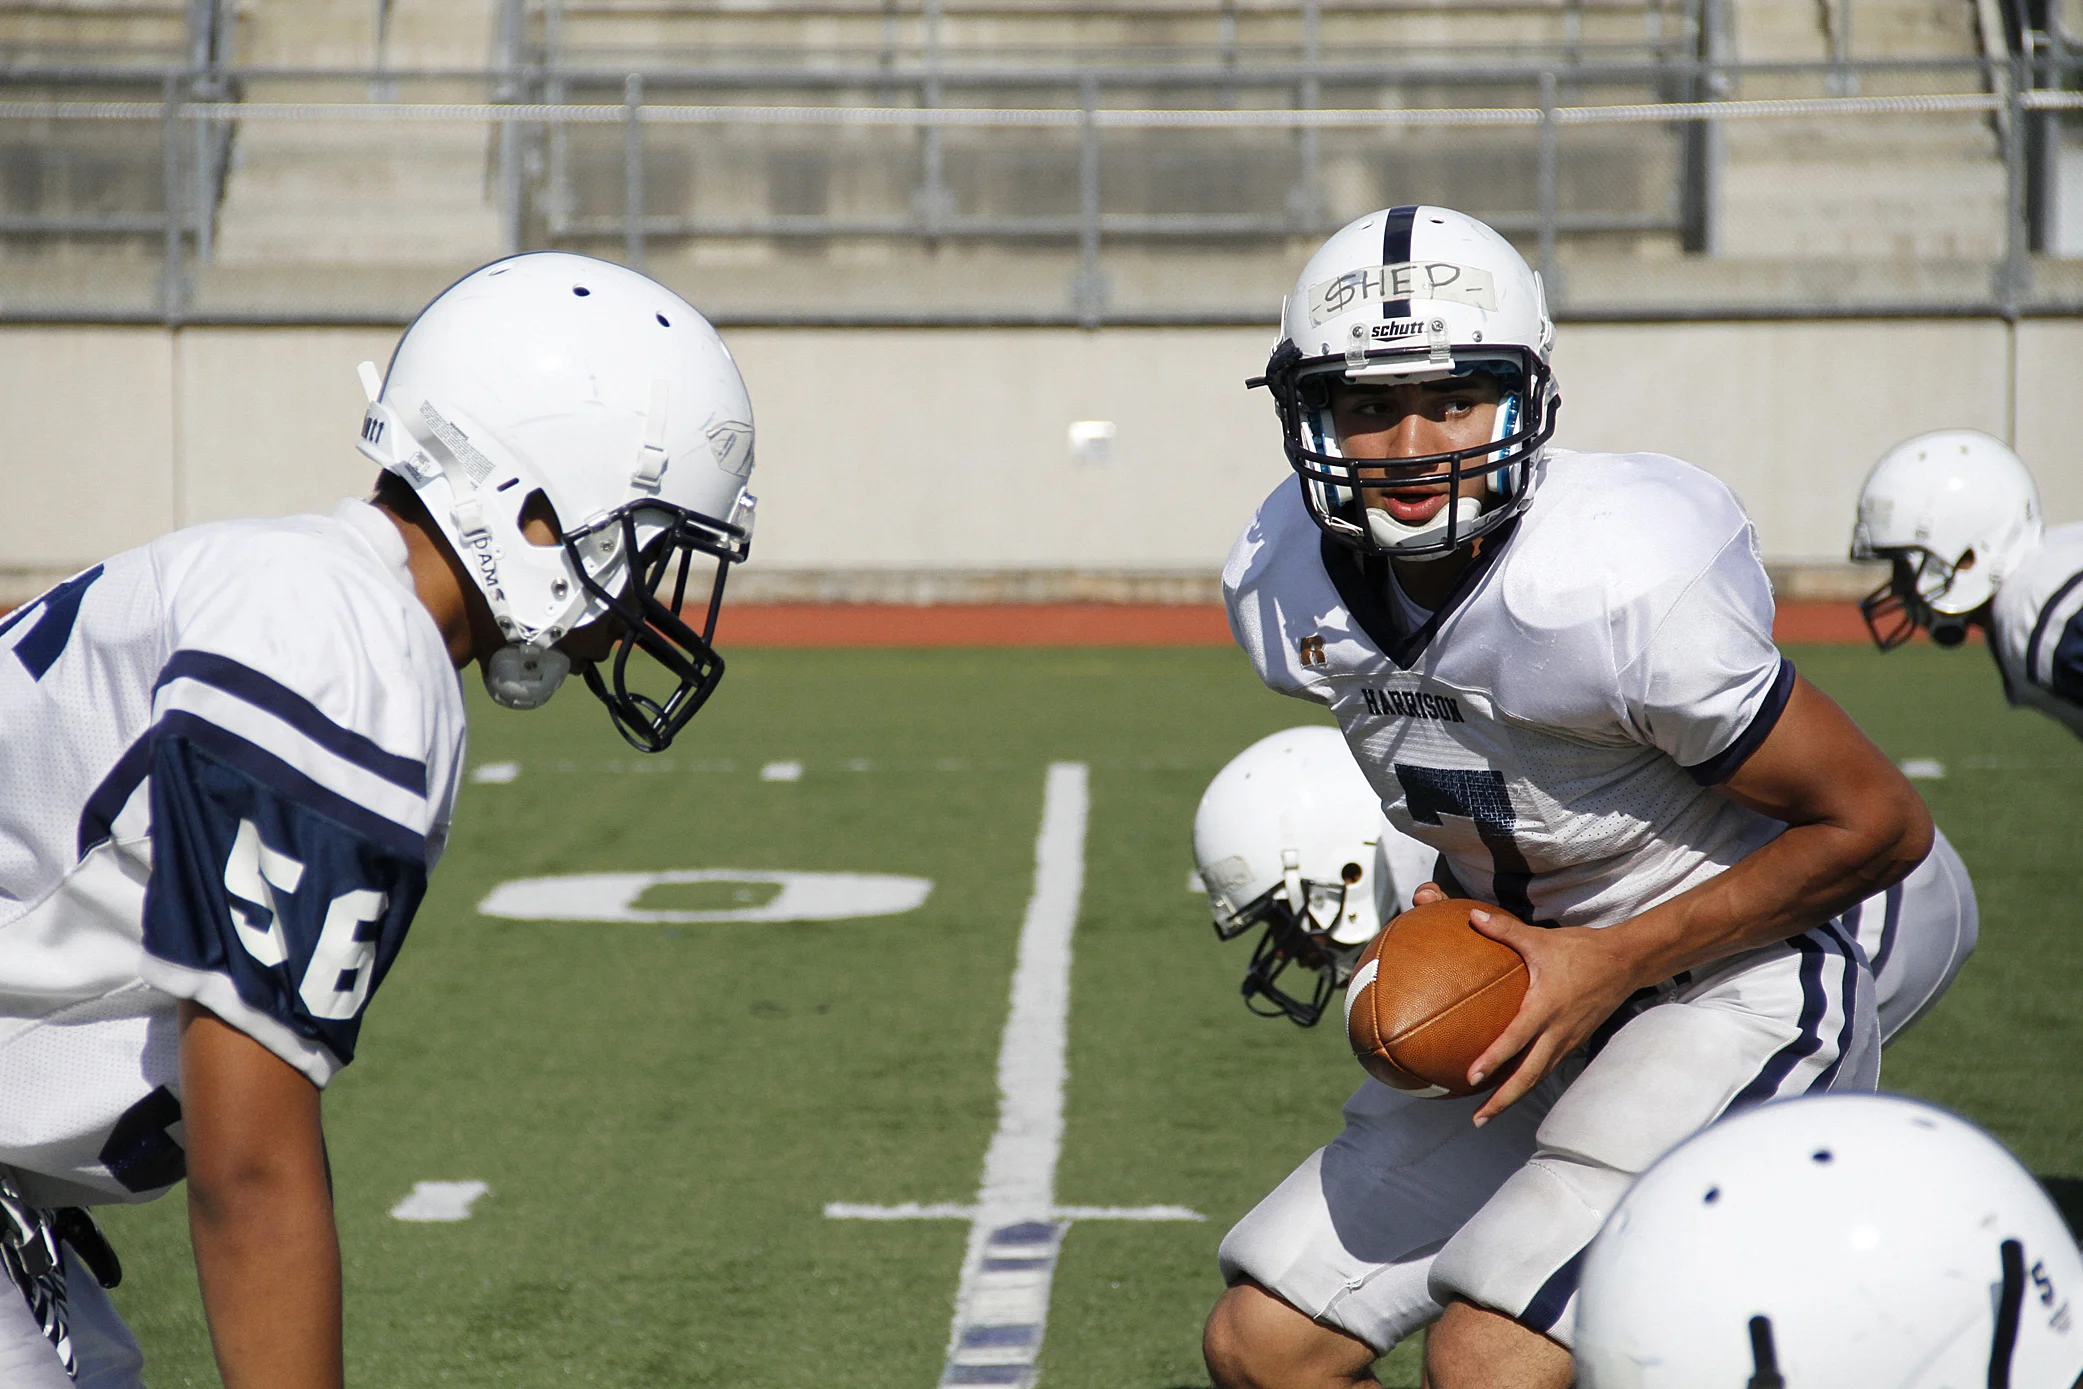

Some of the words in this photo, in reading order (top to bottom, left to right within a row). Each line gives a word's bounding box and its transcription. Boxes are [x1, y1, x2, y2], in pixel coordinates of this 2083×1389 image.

[1371, 321, 1424, 338] schutt
[1361, 688, 1465, 723] HARRISON
[1394, 763, 1536, 924] 7
[224, 818, 389, 1020] 56
[476, 869, 935, 923] 0
